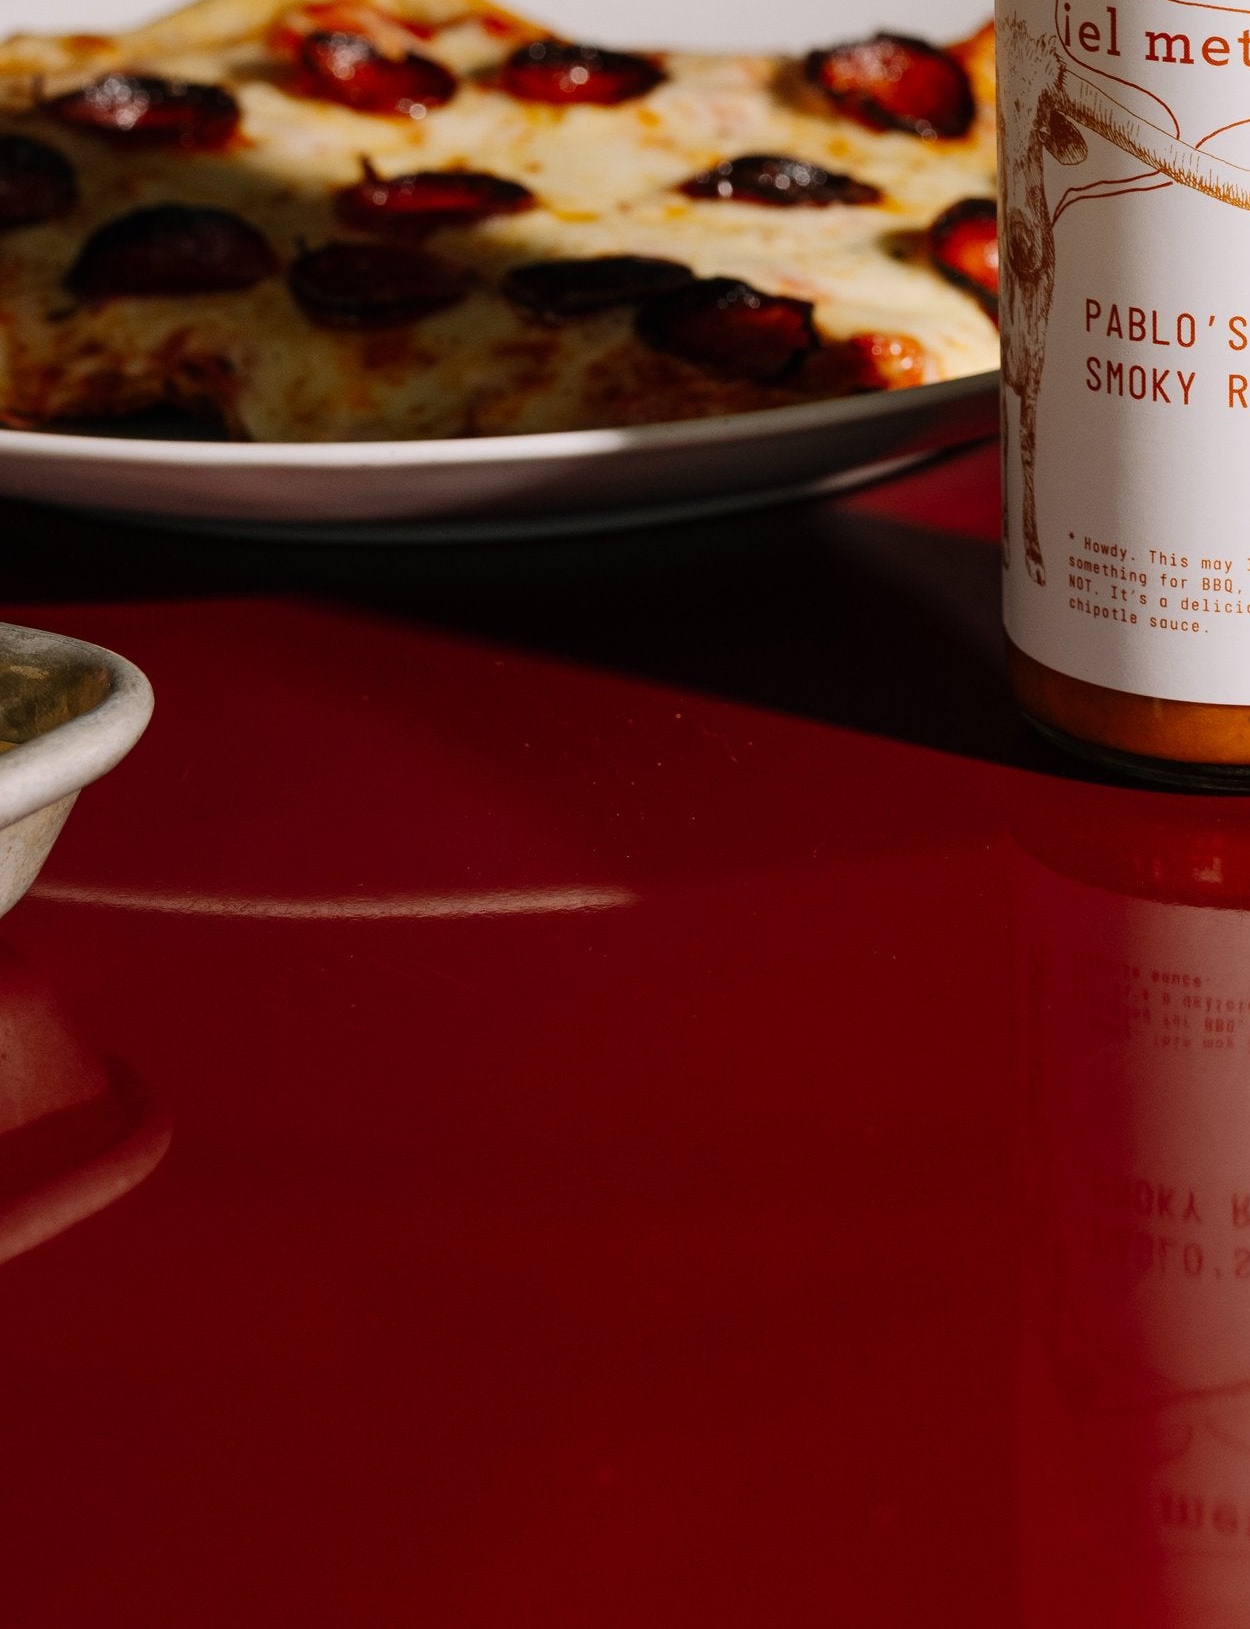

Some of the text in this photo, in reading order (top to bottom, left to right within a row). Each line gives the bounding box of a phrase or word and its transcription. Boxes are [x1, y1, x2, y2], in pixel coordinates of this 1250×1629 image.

[1085, 298, 1248, 351] PABLO'S
[1086, 356, 1196, 405] SMOKY
[1084, 536, 1136, 563] Howdy.
[1149, 550, 1189, 568] This
[1201, 558, 1232, 574] may
[1069, 555, 1147, 586] something
[1160, 573, 1188, 589] for
[1202, 578, 1243, 595] BBQ,
[1069, 574, 1099, 595] NOT.
[1111, 585, 1147, 605] It's
[1160, 597, 1168, 608] a
[1069, 597, 1209, 634] chipotle sauce.
